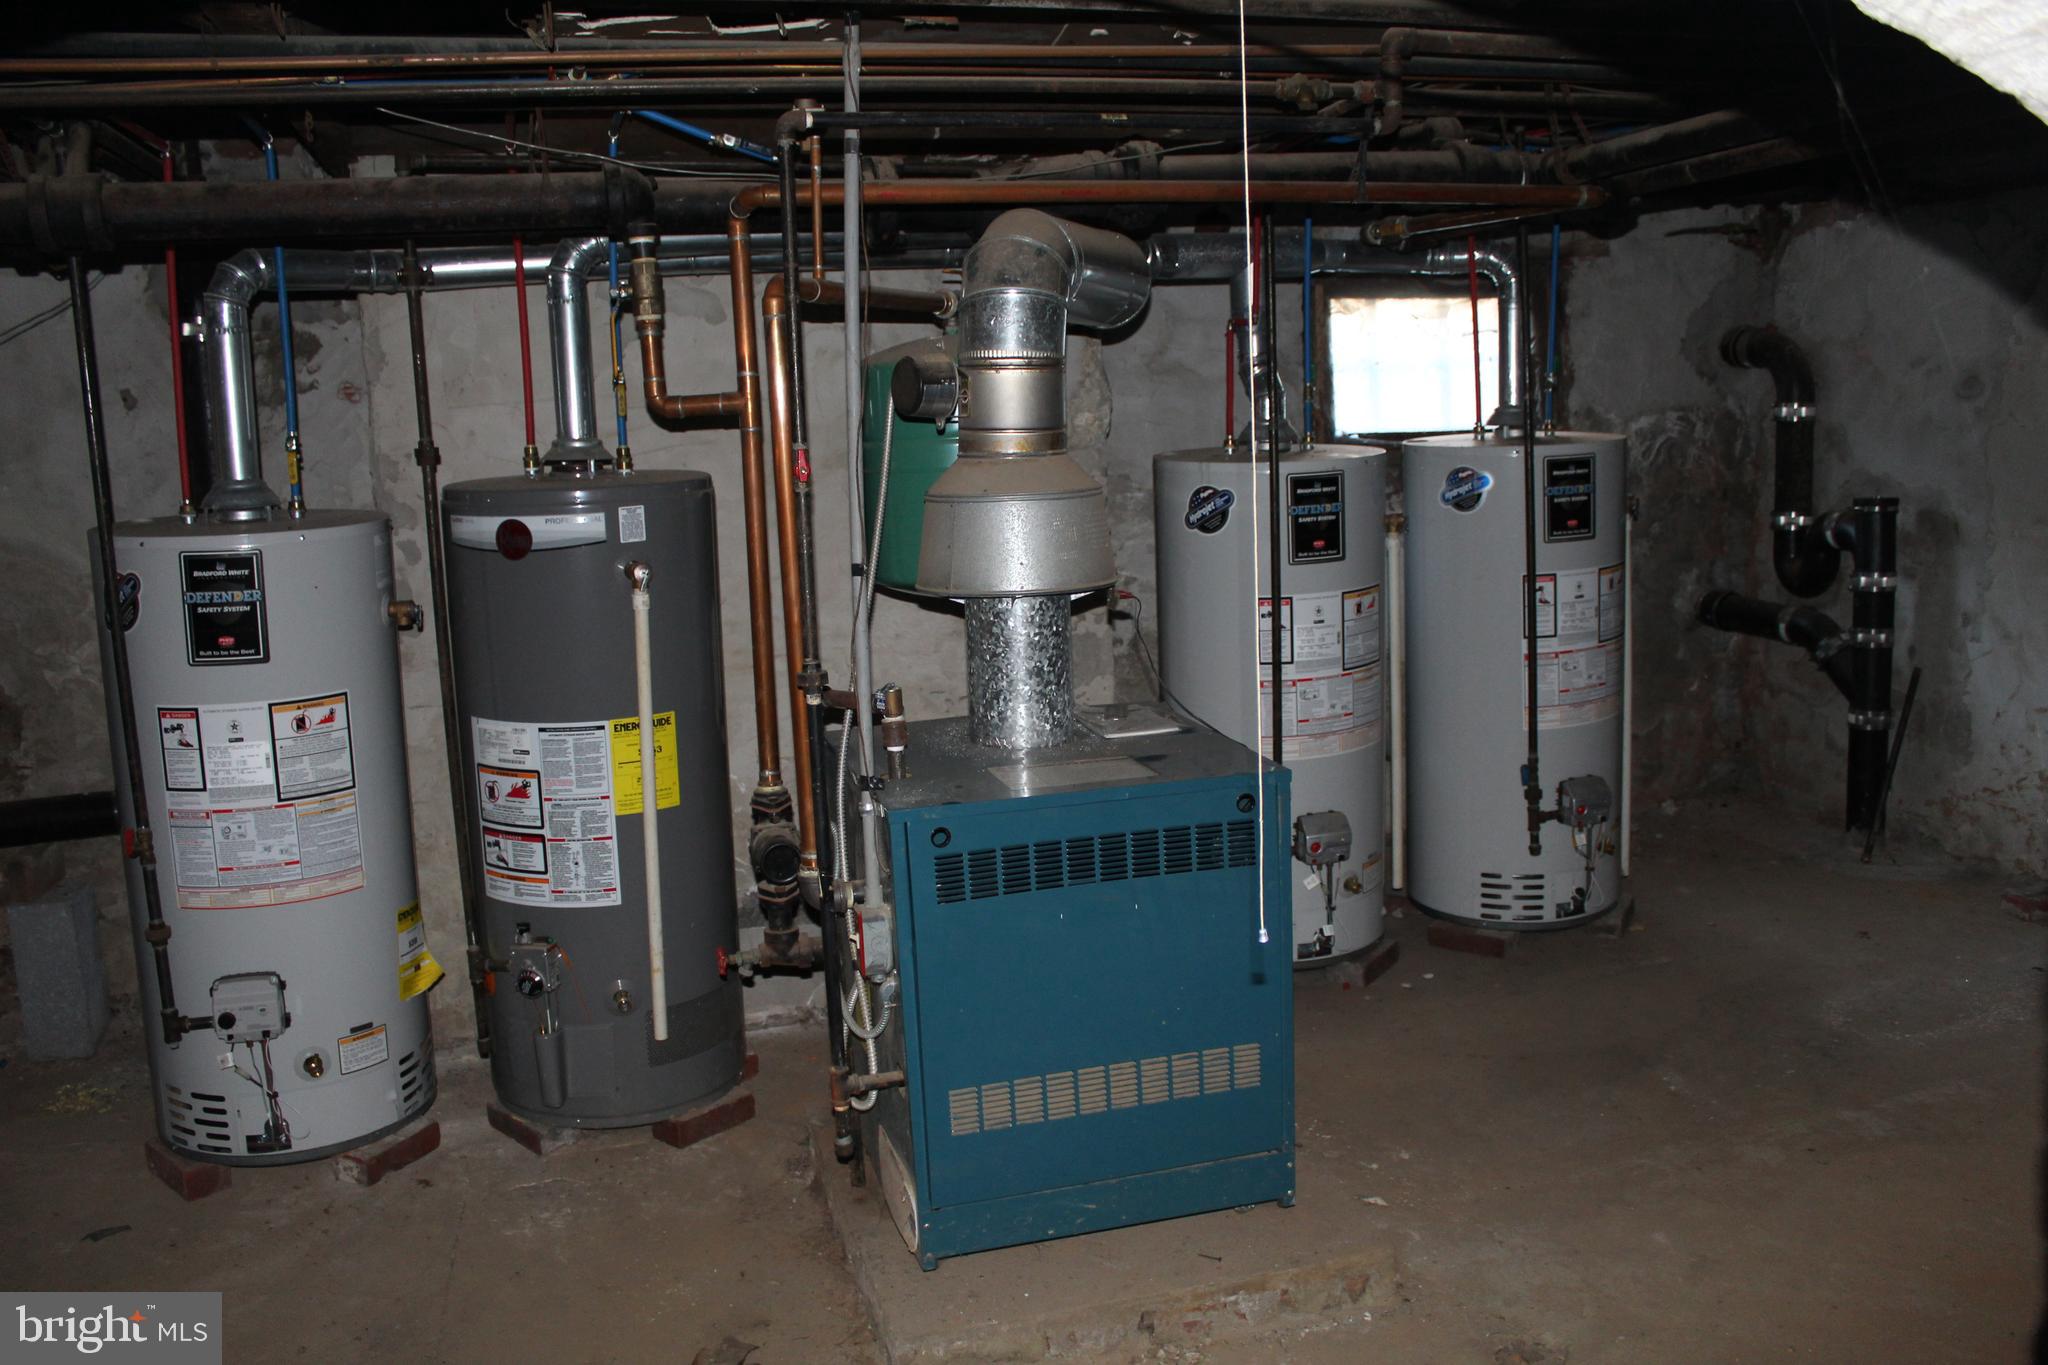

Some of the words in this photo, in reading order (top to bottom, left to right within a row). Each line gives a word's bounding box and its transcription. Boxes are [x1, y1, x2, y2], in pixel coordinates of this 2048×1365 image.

[193, 570, 227, 578] BRADFORD
[185, 590, 263, 604] DEFENDER
[197, 606, 222, 614] SAFETY
[223, 605, 251, 613] SYSTEM
